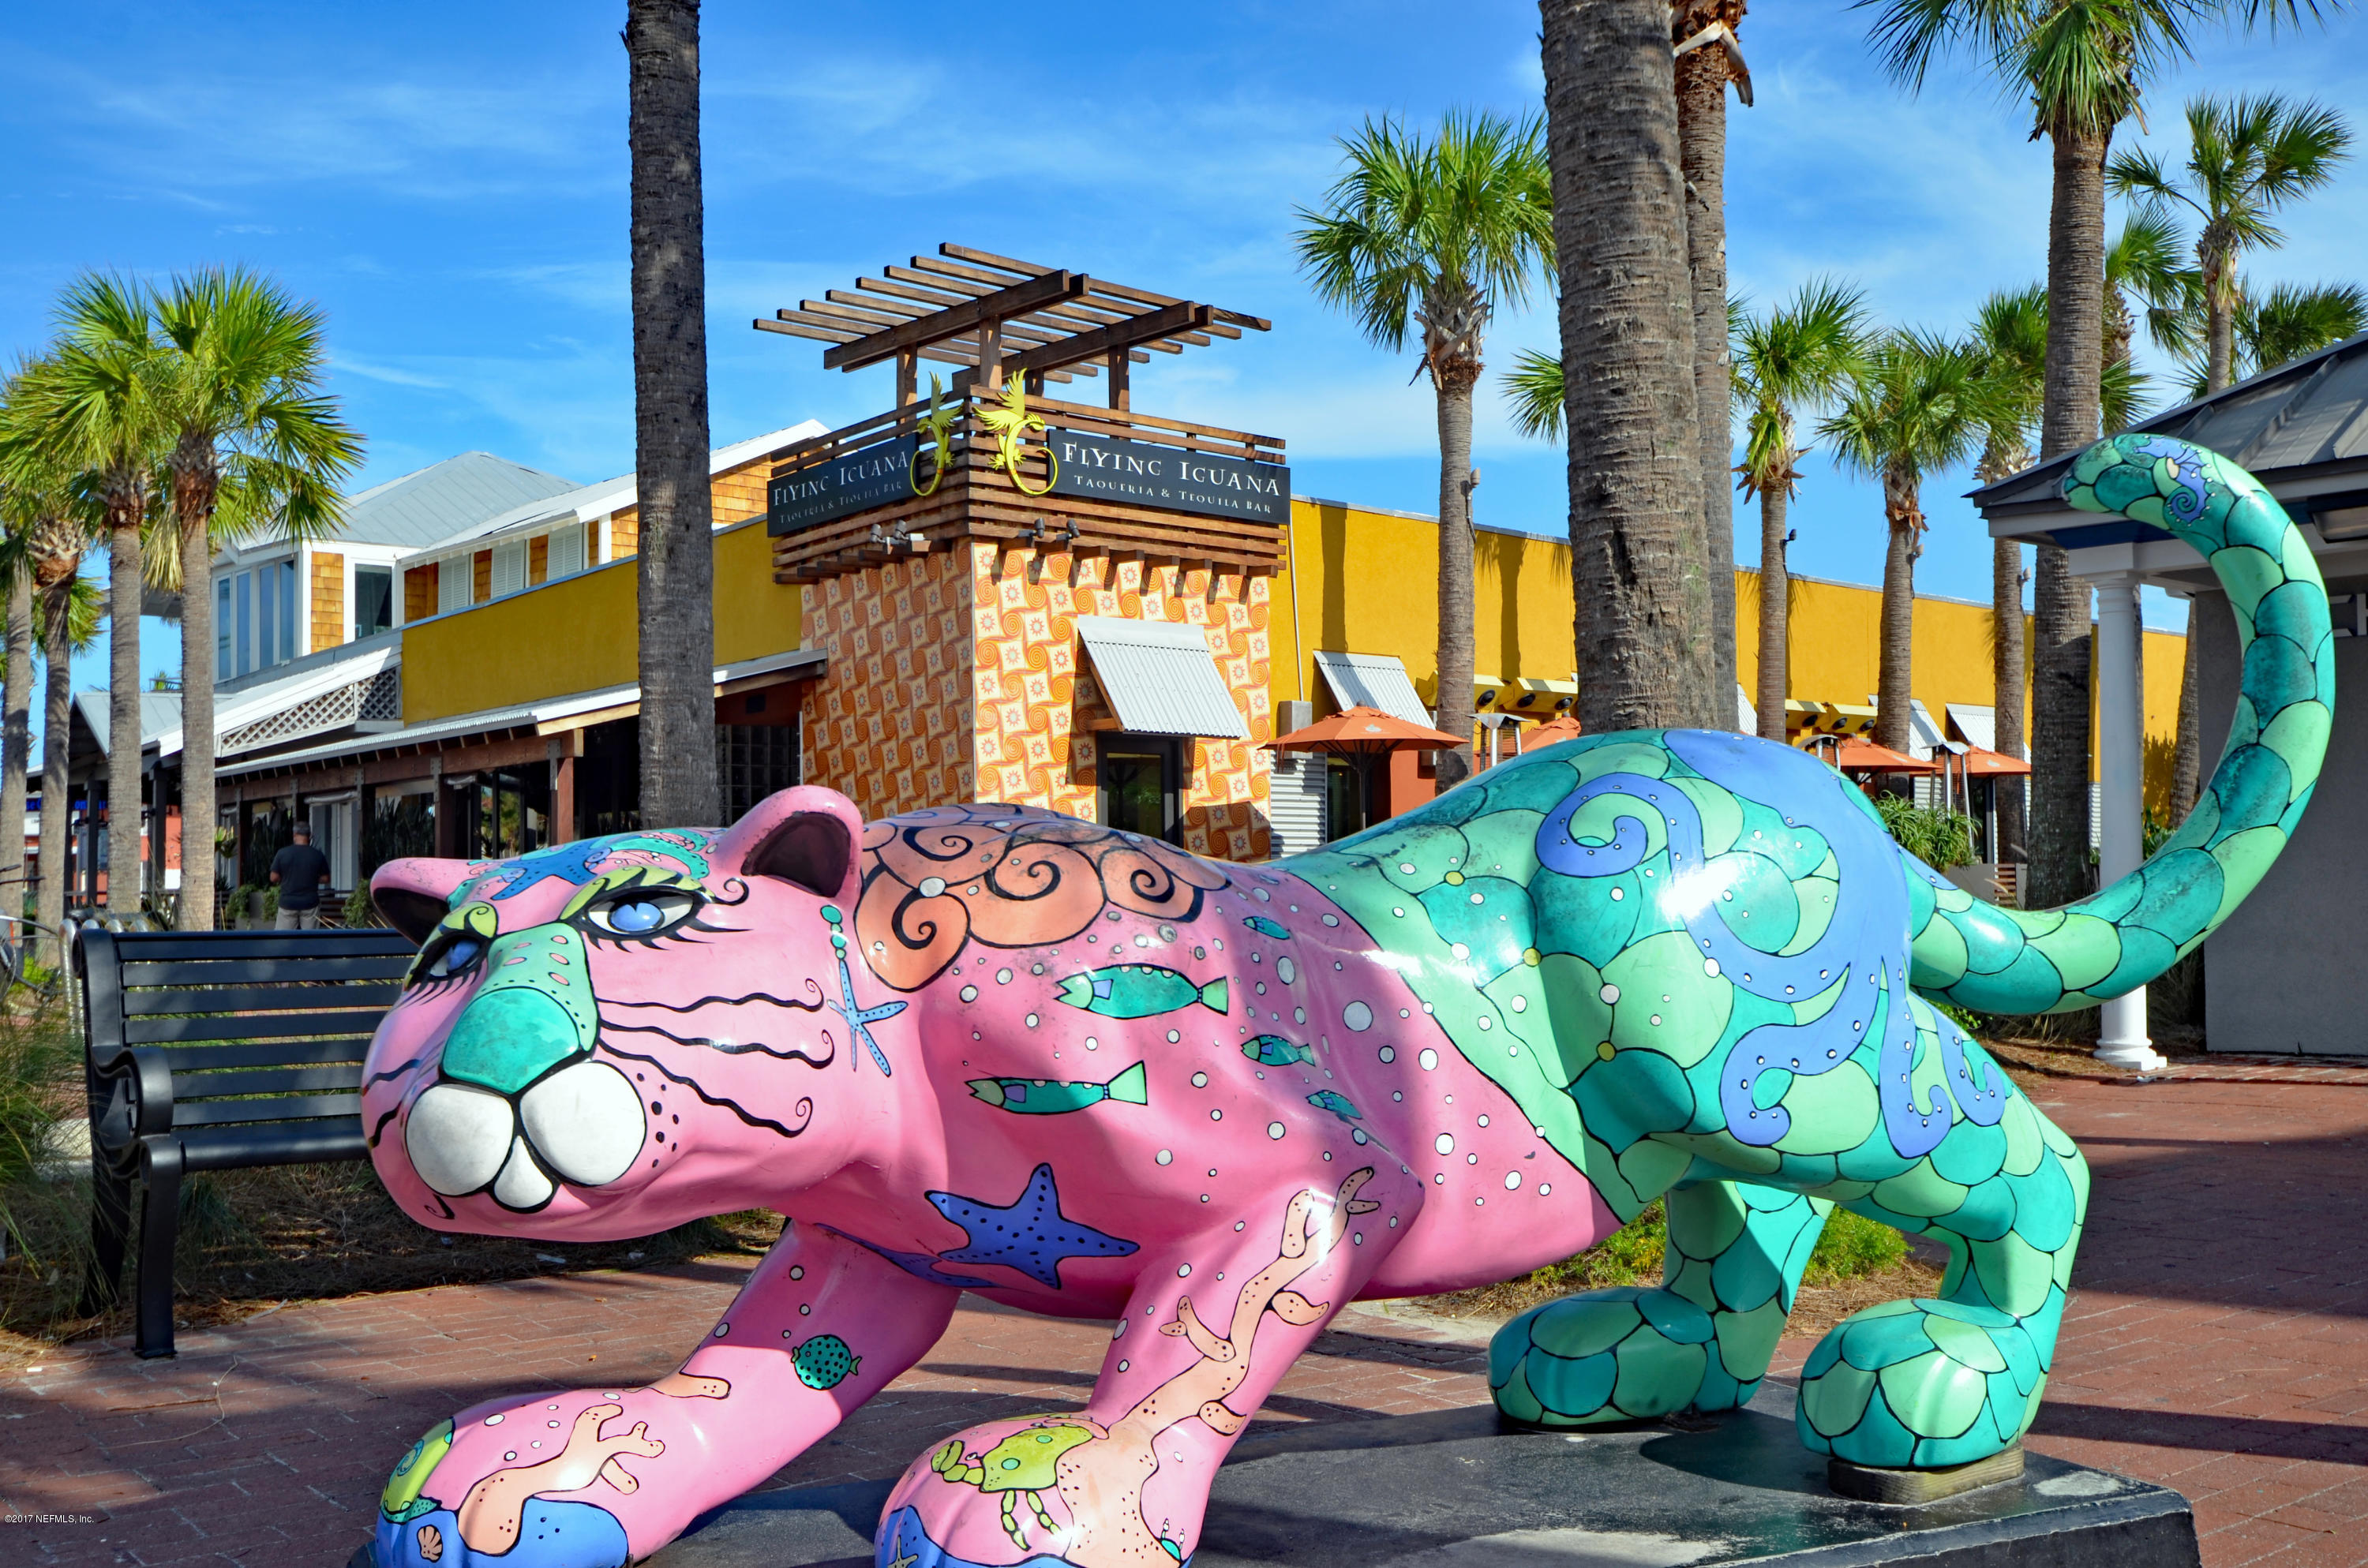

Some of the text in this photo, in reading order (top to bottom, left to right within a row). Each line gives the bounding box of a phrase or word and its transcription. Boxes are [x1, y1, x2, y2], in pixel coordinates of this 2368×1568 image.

[839, 451, 909, 486] IGUANA
[1062, 441, 1281, 496] FLYING IGUANA
[828, 500, 834, 510] &
[1073, 475, 1271, 513] TAQUERIA & TEQUILA BAR
